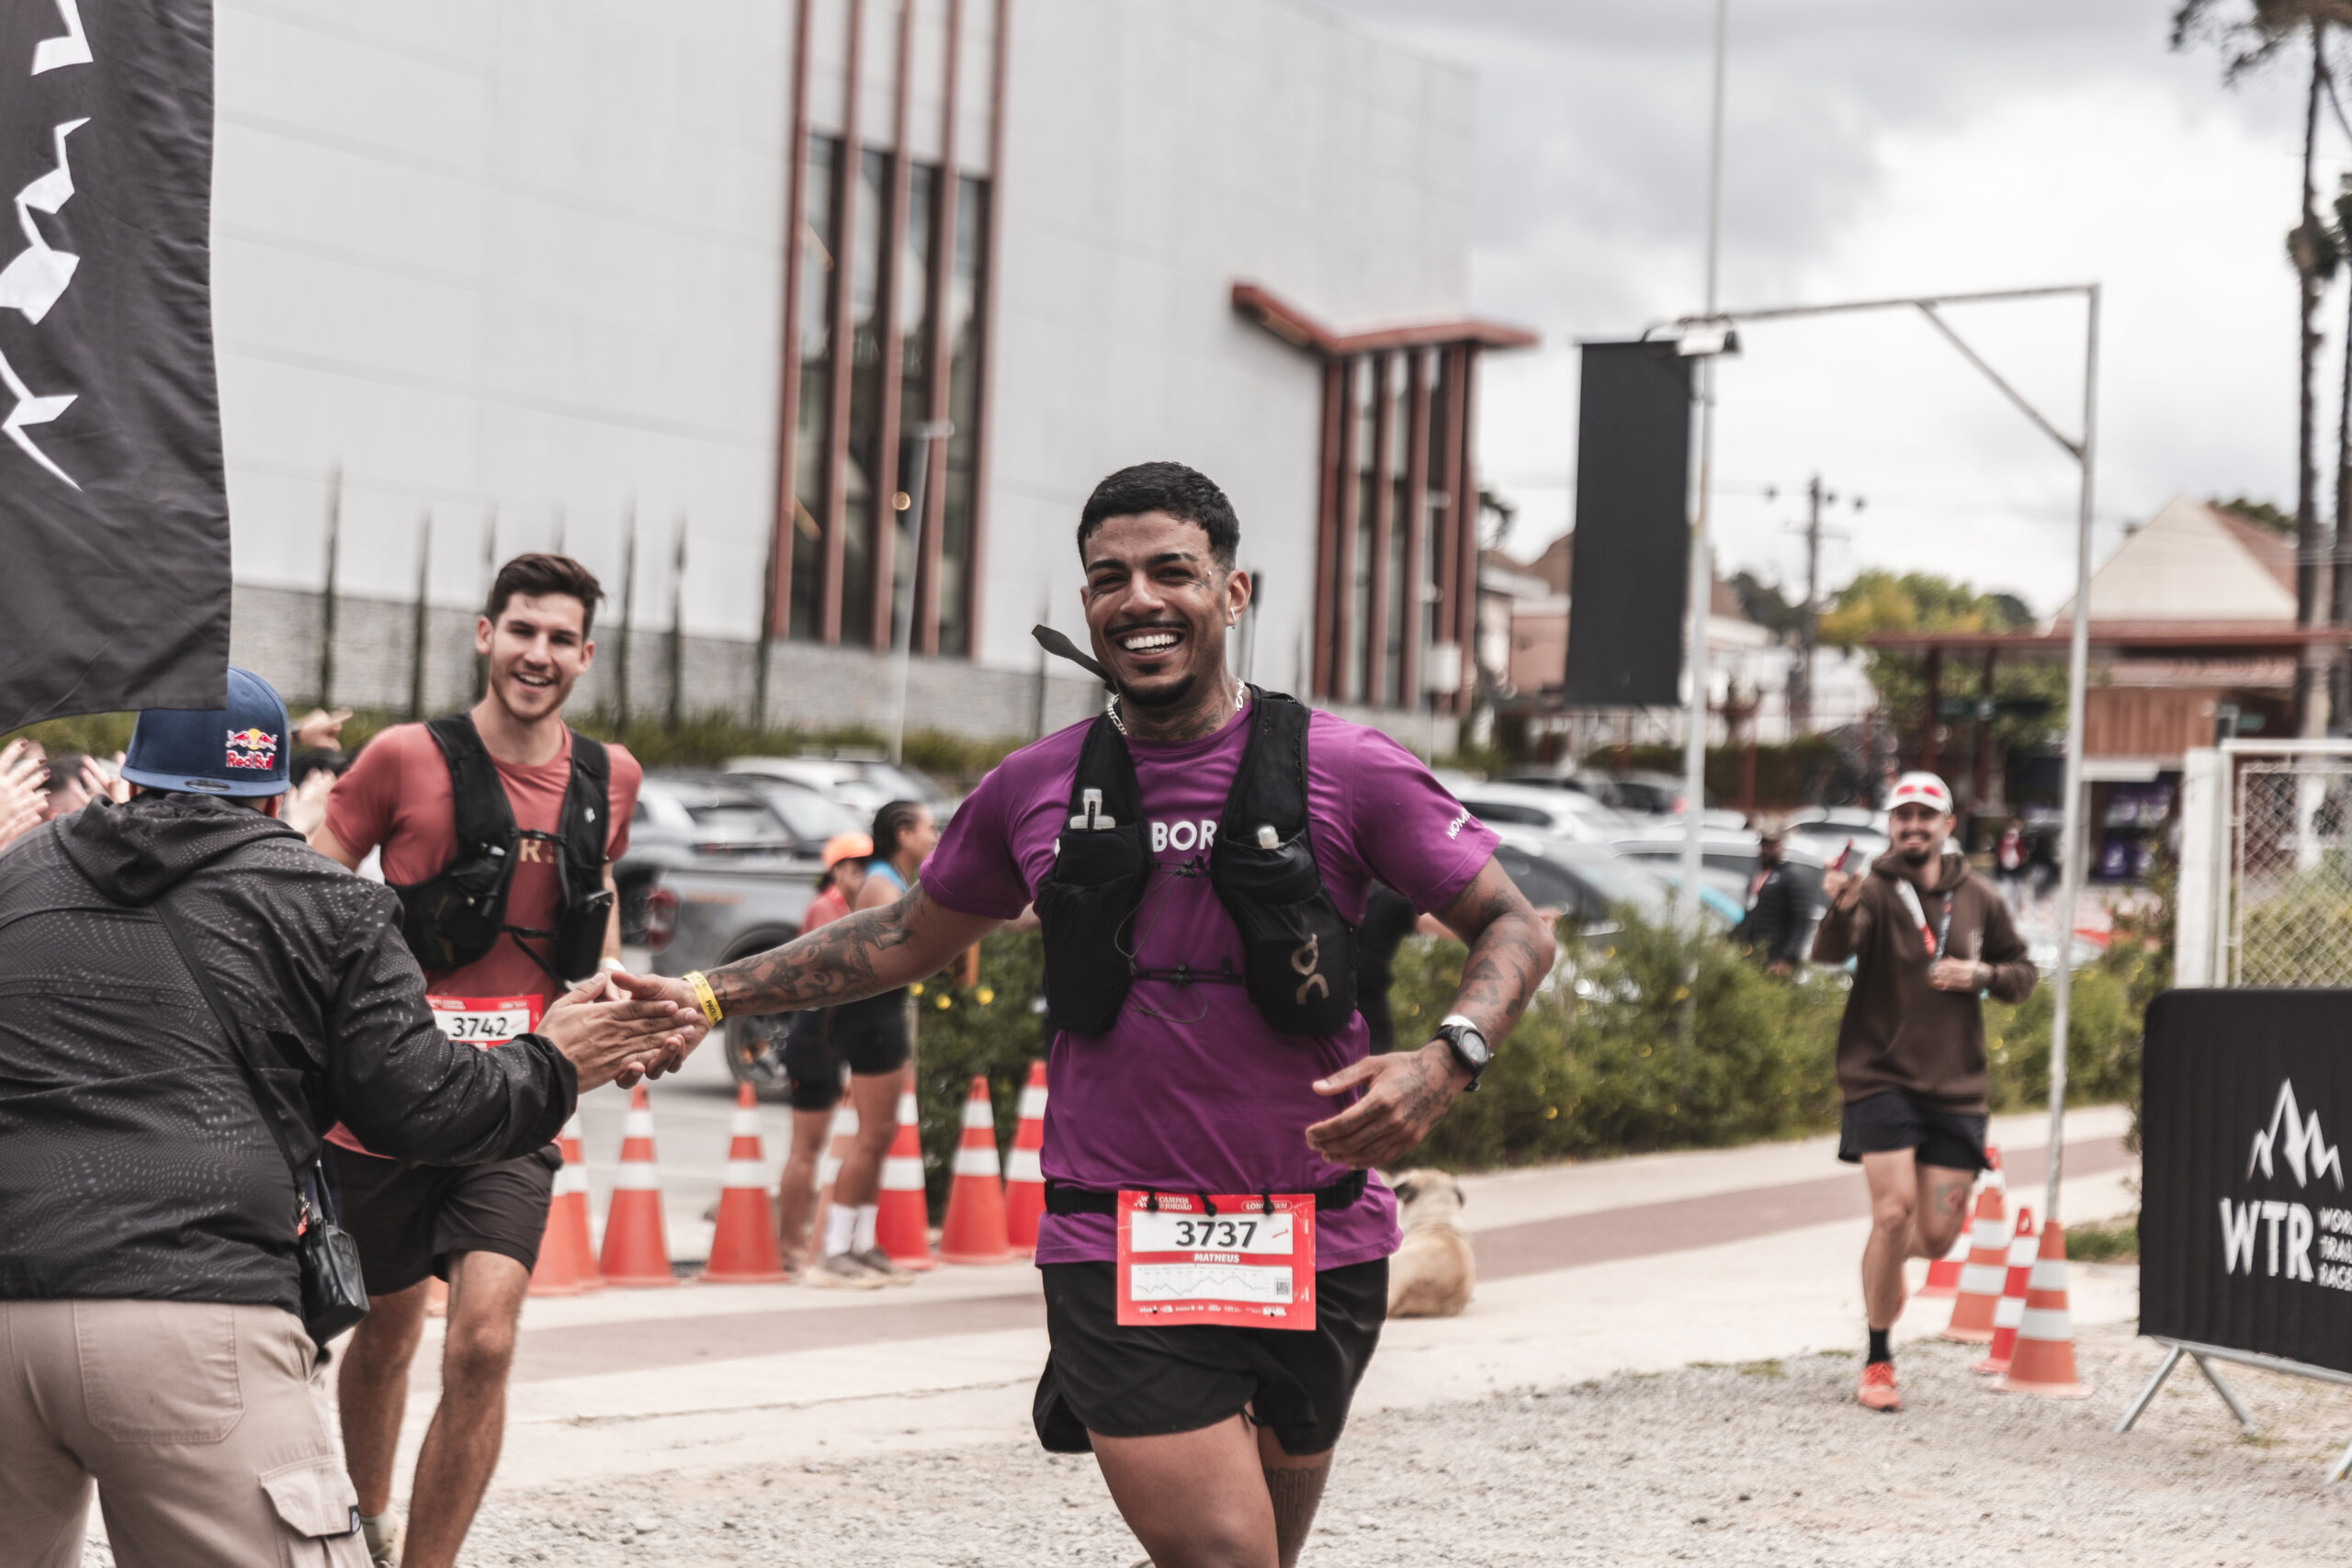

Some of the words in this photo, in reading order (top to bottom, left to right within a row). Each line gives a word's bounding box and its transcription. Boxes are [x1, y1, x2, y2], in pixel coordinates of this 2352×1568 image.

[226, 750, 254, 768] Red
[1152, 820, 1217, 852] BOR
[452, 1017, 508, 1037] 3742
[1159, 1196, 1190, 1204] CAMPOS
[1165, 1202, 1193, 1211] JORDÃO
[1176, 1221, 1258, 1248] 3737
[2219, 1197, 2315, 1282] WTR
[1193, 1252, 1240, 1263] MATHEUS
